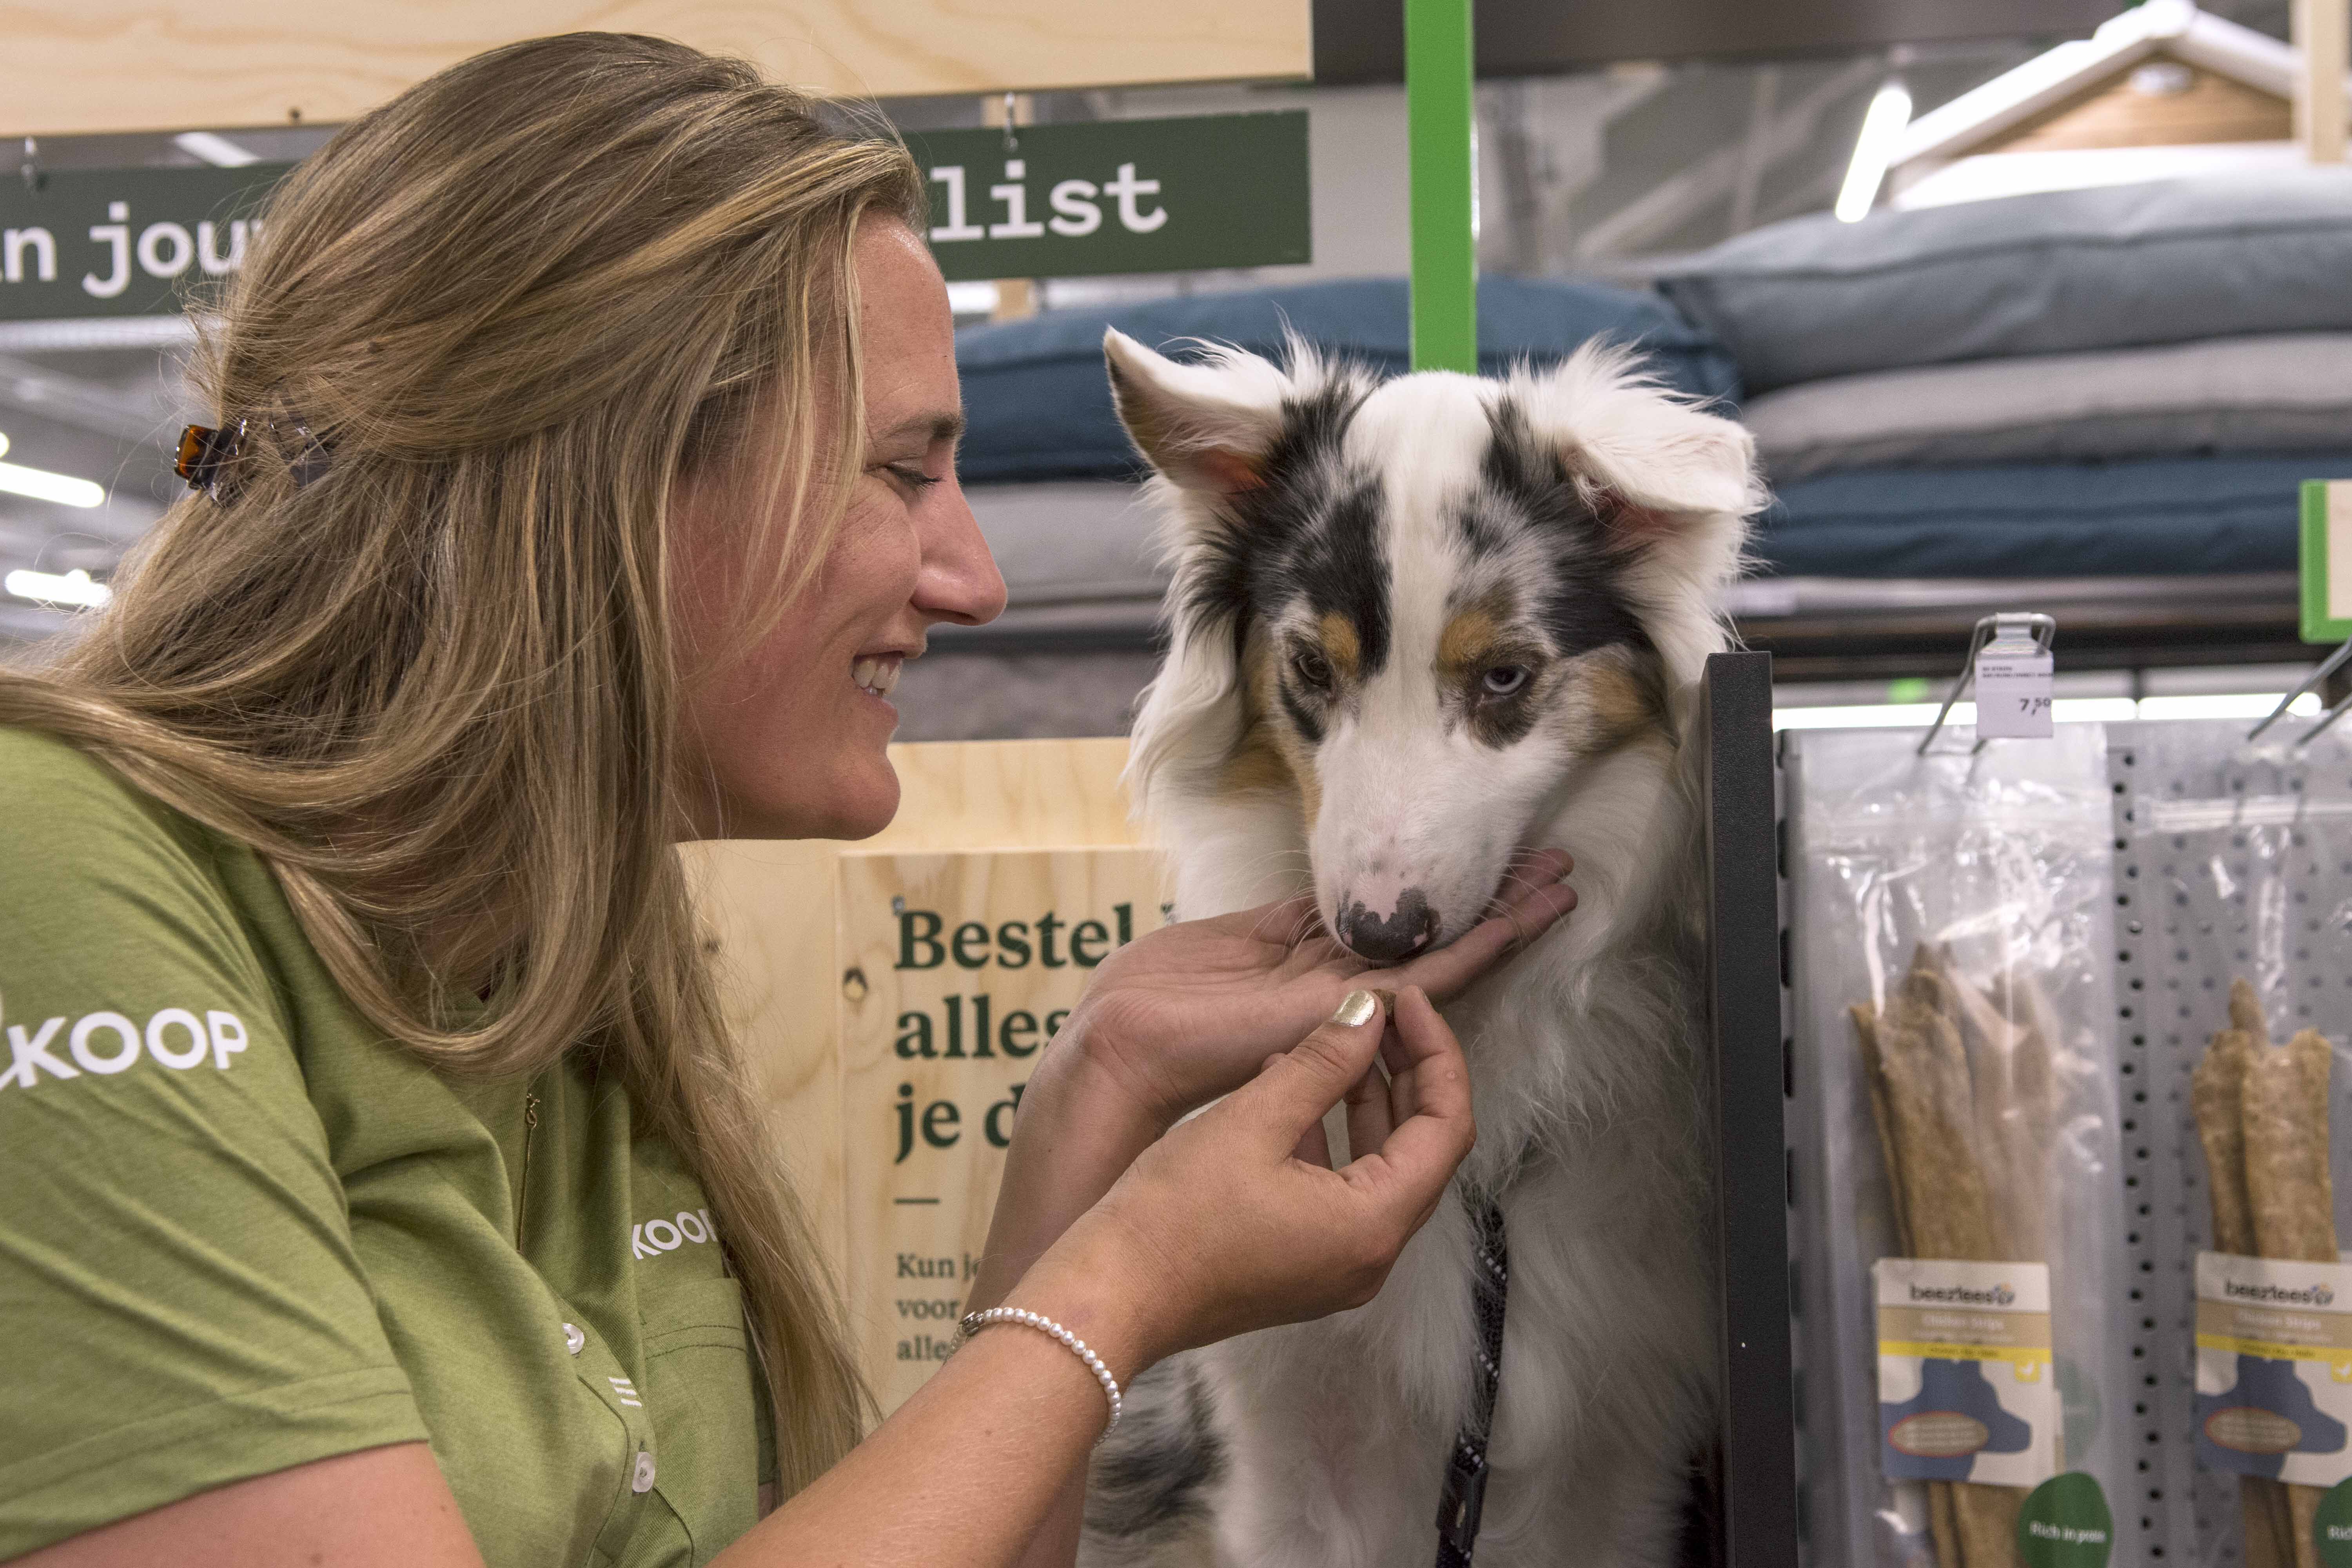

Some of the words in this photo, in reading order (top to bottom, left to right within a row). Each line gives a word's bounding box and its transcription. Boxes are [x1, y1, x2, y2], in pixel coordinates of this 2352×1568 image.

[0, 225, 58, 283] n
[81, 201, 263, 299] jou
[2019, 698, 2051, 717] 7,50
[894, 902, 1132, 970] Bestel
[895, 1083, 961, 1165] je
[896, 1253, 955, 1278] Kun
[896, 1299, 960, 1320] voor
